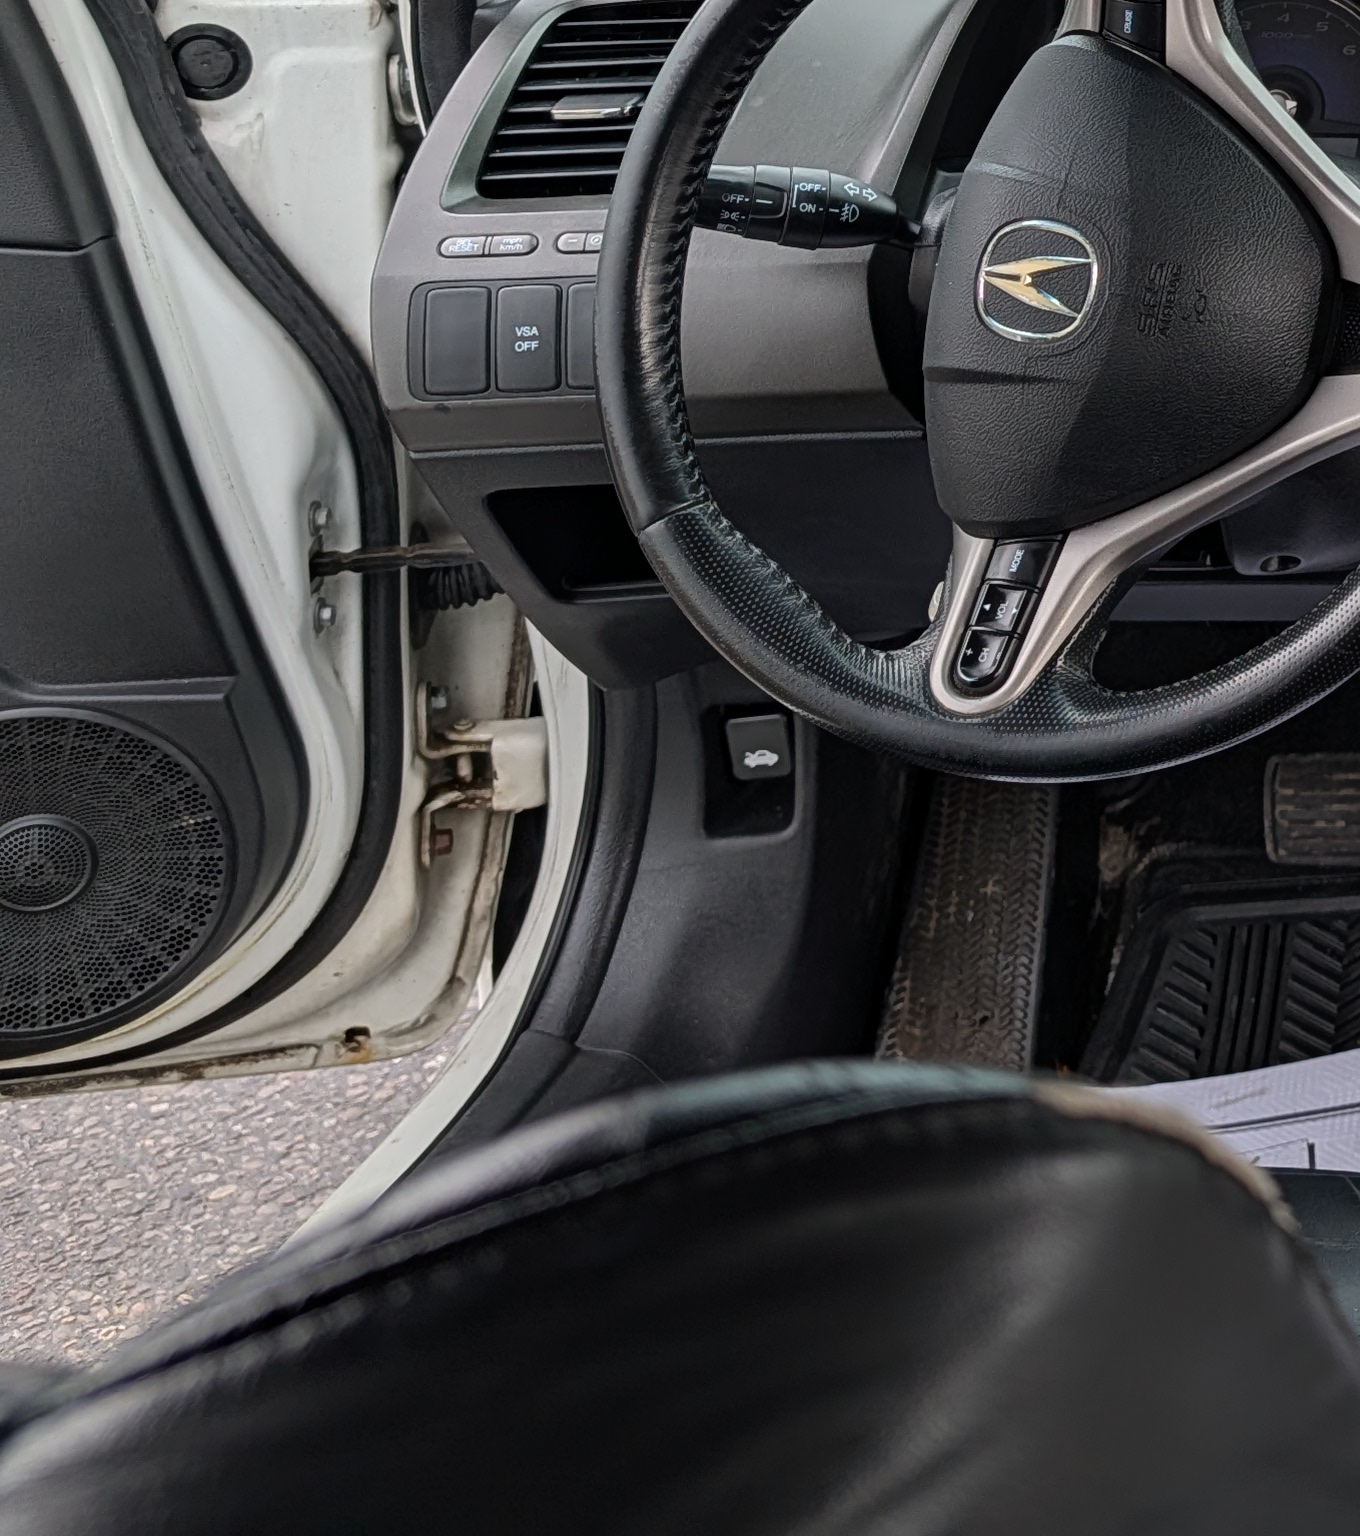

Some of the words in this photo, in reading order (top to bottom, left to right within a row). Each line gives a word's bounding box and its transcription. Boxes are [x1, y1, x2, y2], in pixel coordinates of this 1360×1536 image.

[1124, 9, 1133, 34] CRUISE
[1276, 13, 1290, 23] 4
[1315, 21, 1329, 32] 5
[1343, 44, 1357, 56] 6
[799, 182, 822, 193] OFF
[721, 192, 745, 204] OFF
[799, 203, 816, 213] ON
[448, 244, 480, 252] RESET
[499, 243, 523, 251] km/h
[514, 325, 540, 337] VSA
[514, 340, 540, 352] OFF
[1009, 548, 1025, 573] MODE
[995, 600, 1009, 620] VOL
[978, 647, 990, 663] CH
